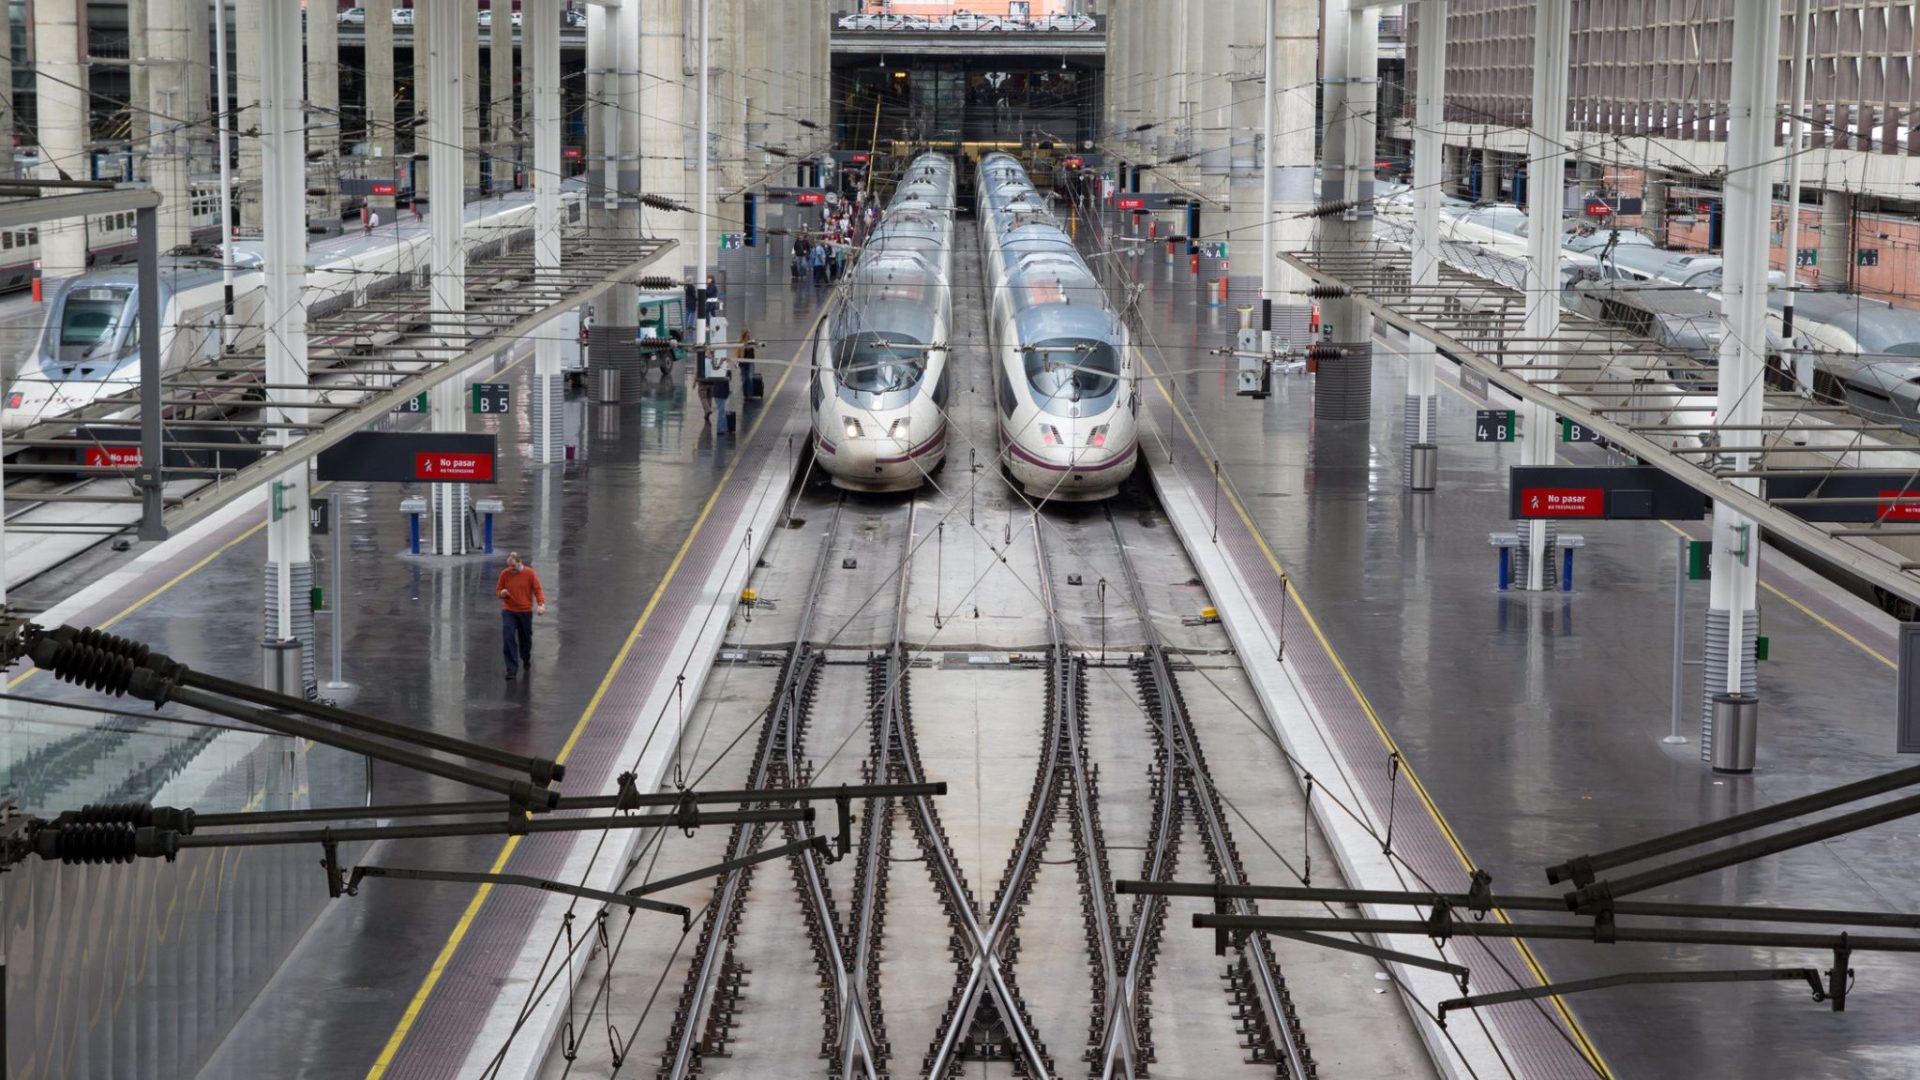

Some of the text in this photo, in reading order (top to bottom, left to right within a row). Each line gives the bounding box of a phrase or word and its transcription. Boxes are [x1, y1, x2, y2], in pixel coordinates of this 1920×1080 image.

[1806, 256, 1812, 264] A
[1862, 256, 1868, 264] A
[410, 398, 419, 412] B
[480, 398, 508, 412] B 5
[1478, 424, 1506, 440] 4 B
[1571, 425, 1580, 440] B
[1562, 496, 1586, 504] pasar
